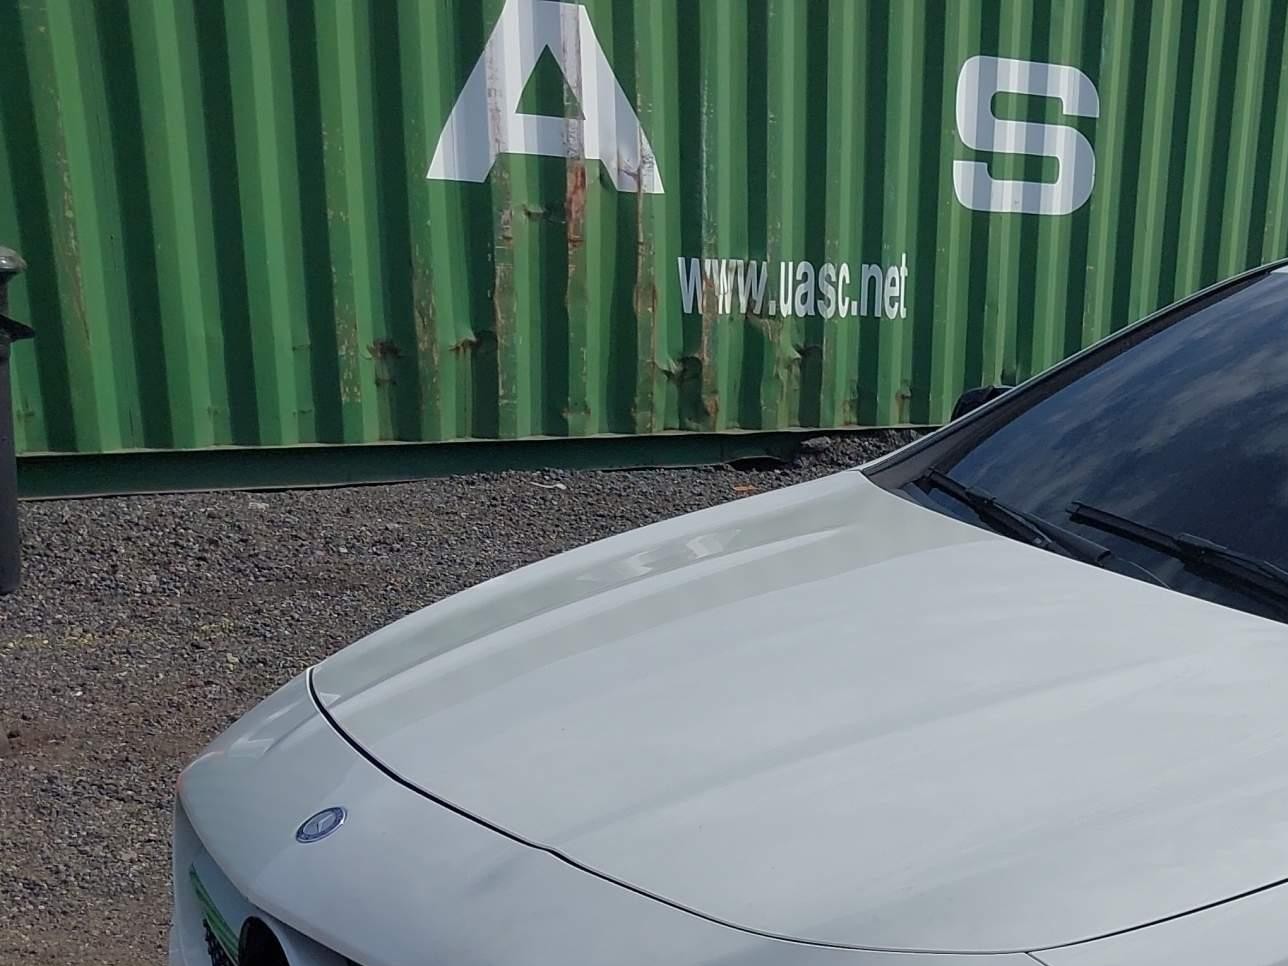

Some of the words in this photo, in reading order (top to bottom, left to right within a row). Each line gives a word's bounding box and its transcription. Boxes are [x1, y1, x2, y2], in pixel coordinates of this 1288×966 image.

[426, 0, 665, 195] A
[953, 55, 1100, 216] S
[678, 253, 908, 319] www.uasc.net
